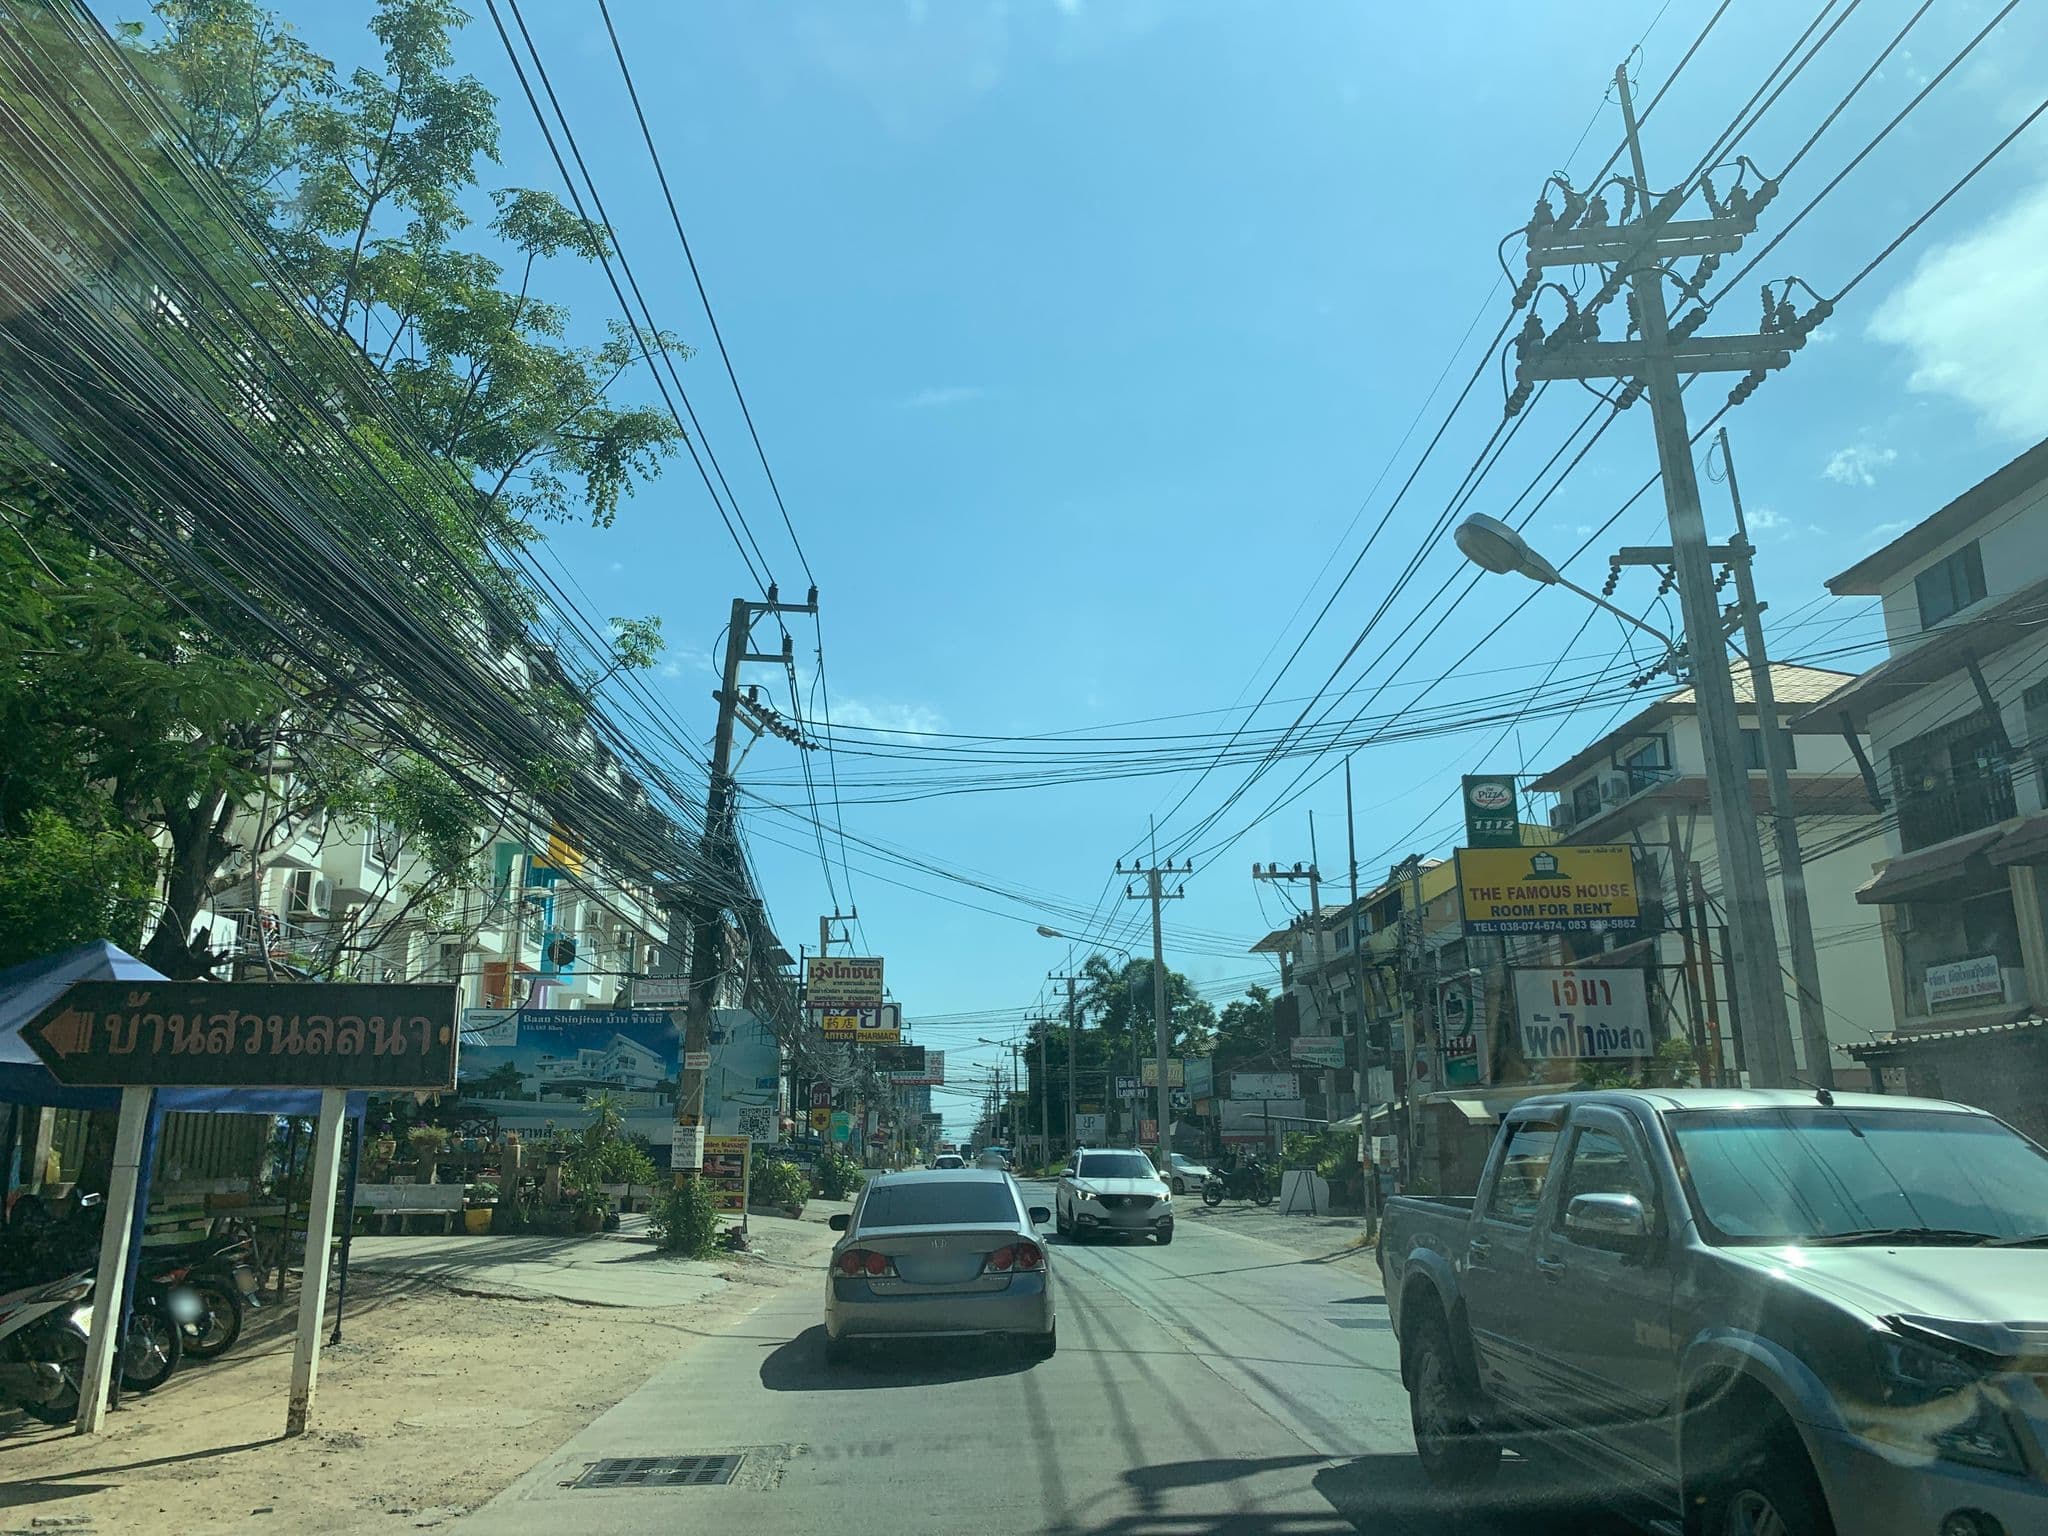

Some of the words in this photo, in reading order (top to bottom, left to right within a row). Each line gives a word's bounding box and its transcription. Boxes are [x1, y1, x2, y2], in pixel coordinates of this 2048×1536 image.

[1474, 820, 1515, 830] 1112
[1469, 887, 1502, 901] THE
[1507, 884, 1571, 900] FAMOUS
[1576, 883, 1630, 898] HOUSE
[1490, 905, 1535, 917] ROOM
[1539, 904, 1569, 916] FOR
[1573, 903, 1613, 915] RENT
[1473, 922, 1498, 932] TEL:
[1568, 920, 1587, 930] 083
[105, 991, 431, 1056] บ้านสวนลลนา
[523, 1014, 551, 1024] Baan
[857, 1031, 898, 1040] PHARMACY
